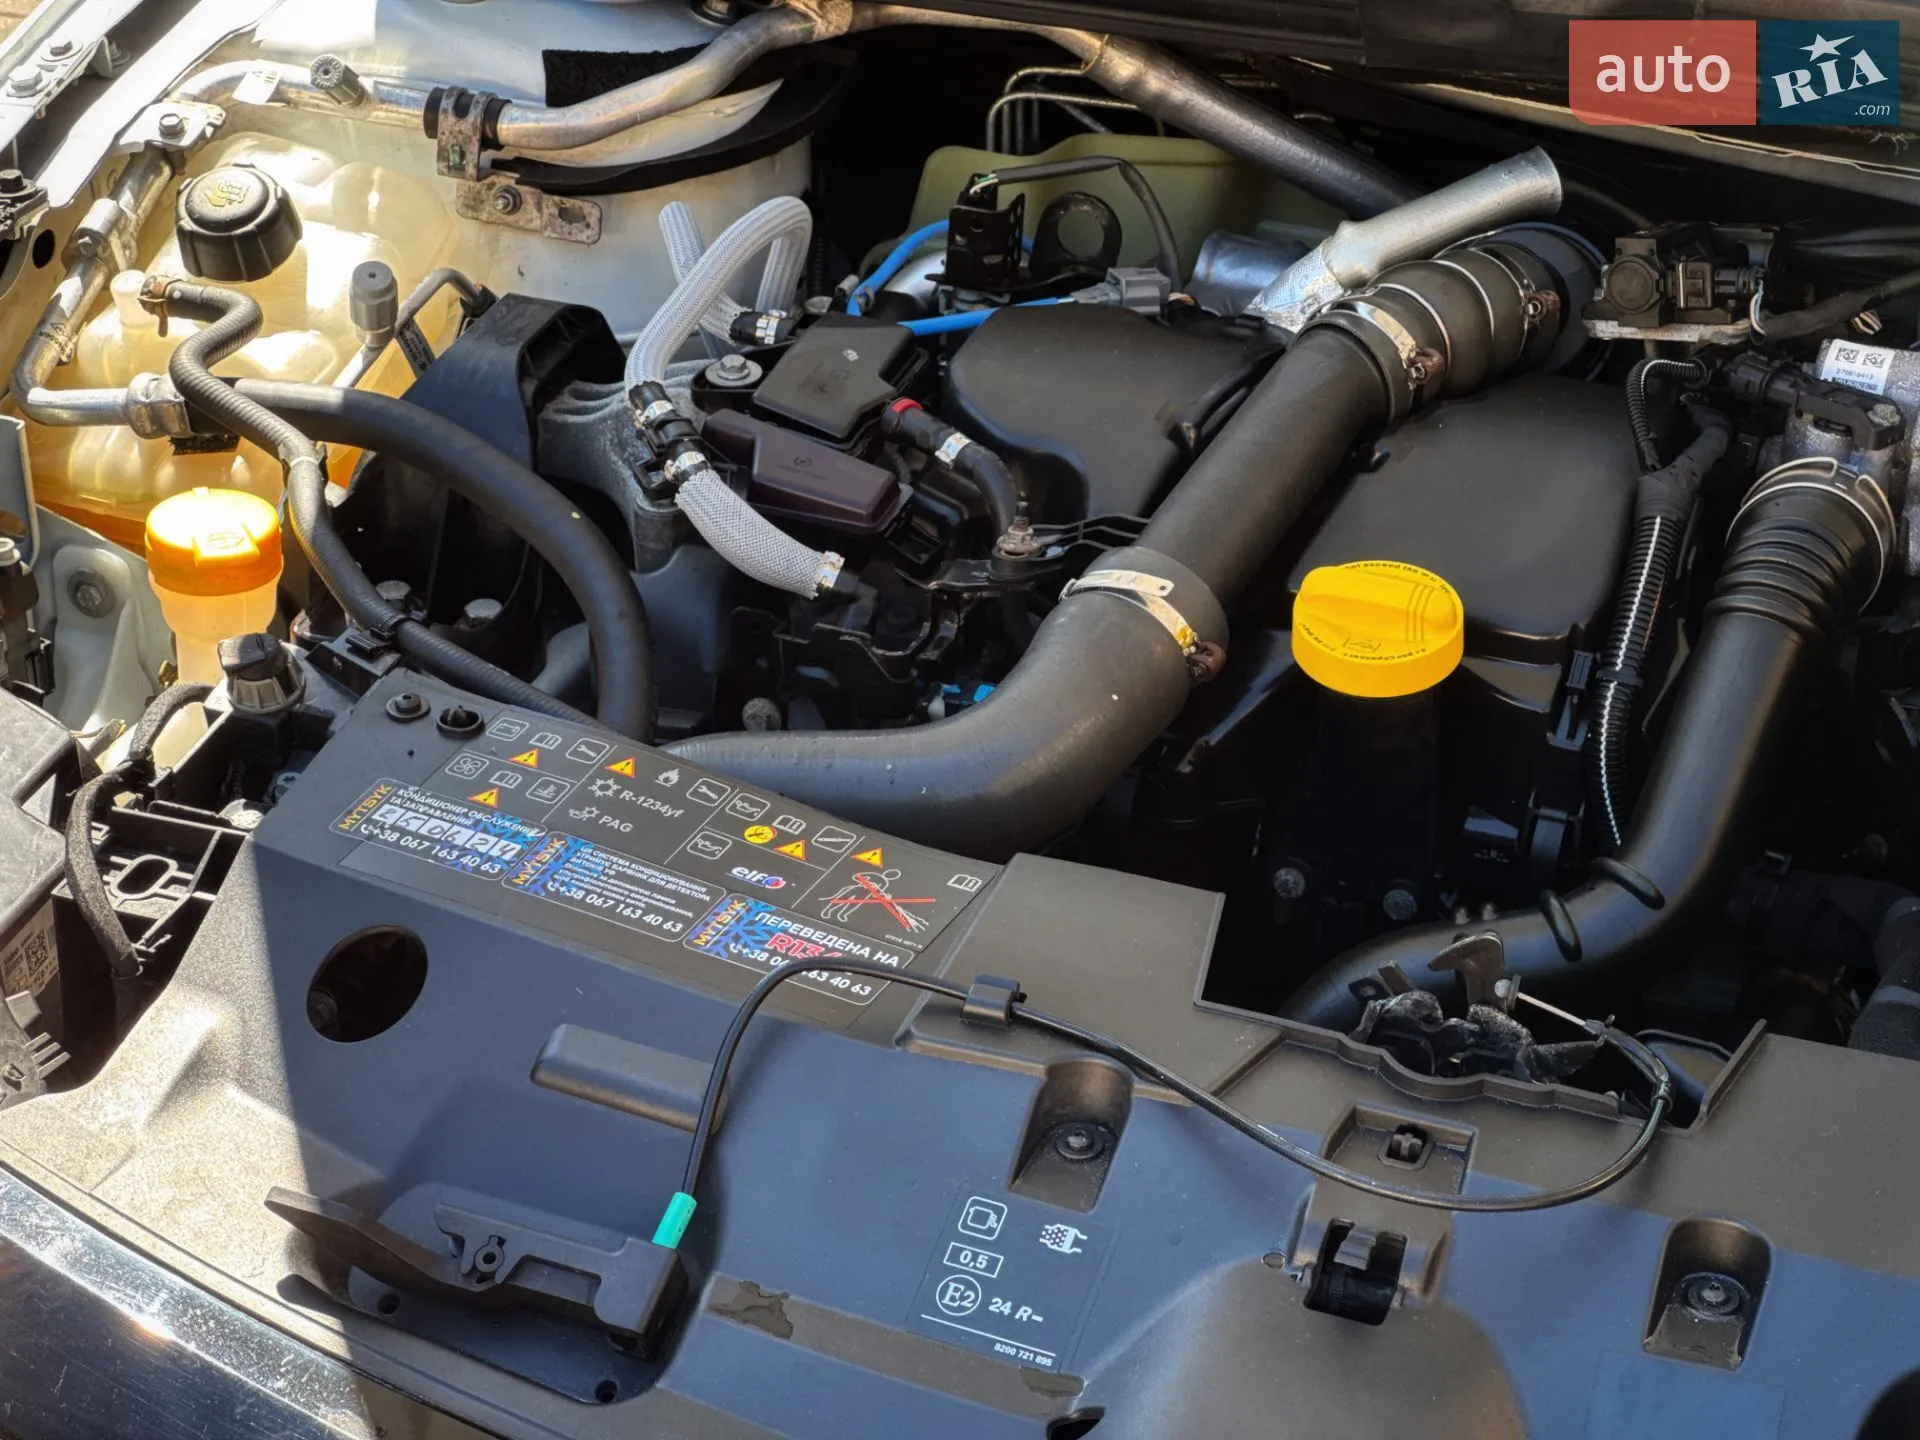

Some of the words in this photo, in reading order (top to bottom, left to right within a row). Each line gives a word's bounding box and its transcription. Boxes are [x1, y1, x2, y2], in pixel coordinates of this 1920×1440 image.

[338, 785, 392, 829] MYTSYK
[402, 800, 473, 826] ЗАПРАВЛЕНИЙ
[619, 790, 685, 818] R-1234yf
[599, 815, 633, 833] PAG
[372, 828, 400, 842] +38
[400, 835, 431, 850] 067
[431, 845, 459, 860] 163
[460, 854, 480, 867] 40
[480, 861, 501, 874] 63
[512, 837, 565, 884] MYTSYK
[593, 850, 630, 866] СИСТЕМА
[646, 877, 666, 887] ДЛЯ
[664, 882, 711, 902] ДЕТЕКТОРА
[559, 885, 585, 899] +38
[586, 894, 615, 908] 067
[616, 904, 642, 918] 163
[642, 913, 663, 926] 40
[662, 920, 683, 932] 63
[693, 899, 747, 945] MYTSYK
[755, 912, 871, 957] ПЕРЕВЕДЕНА
[873, 951, 899, 967] НА
[765, 933, 842, 959] R13
[742, 948, 769, 961] +38
[829, 976, 850, 988] 40
[851, 983, 871, 995] 63
[959, 1250, 989, 1269] 0,5
[941, 1282, 976, 1307] E2
[988, 1298, 1012, 1315] 24
[994, 1343, 1016, 1356] 8200
[1018, 1350, 1034, 1361] 721
[1035, 1355, 1053, 1367] 895
